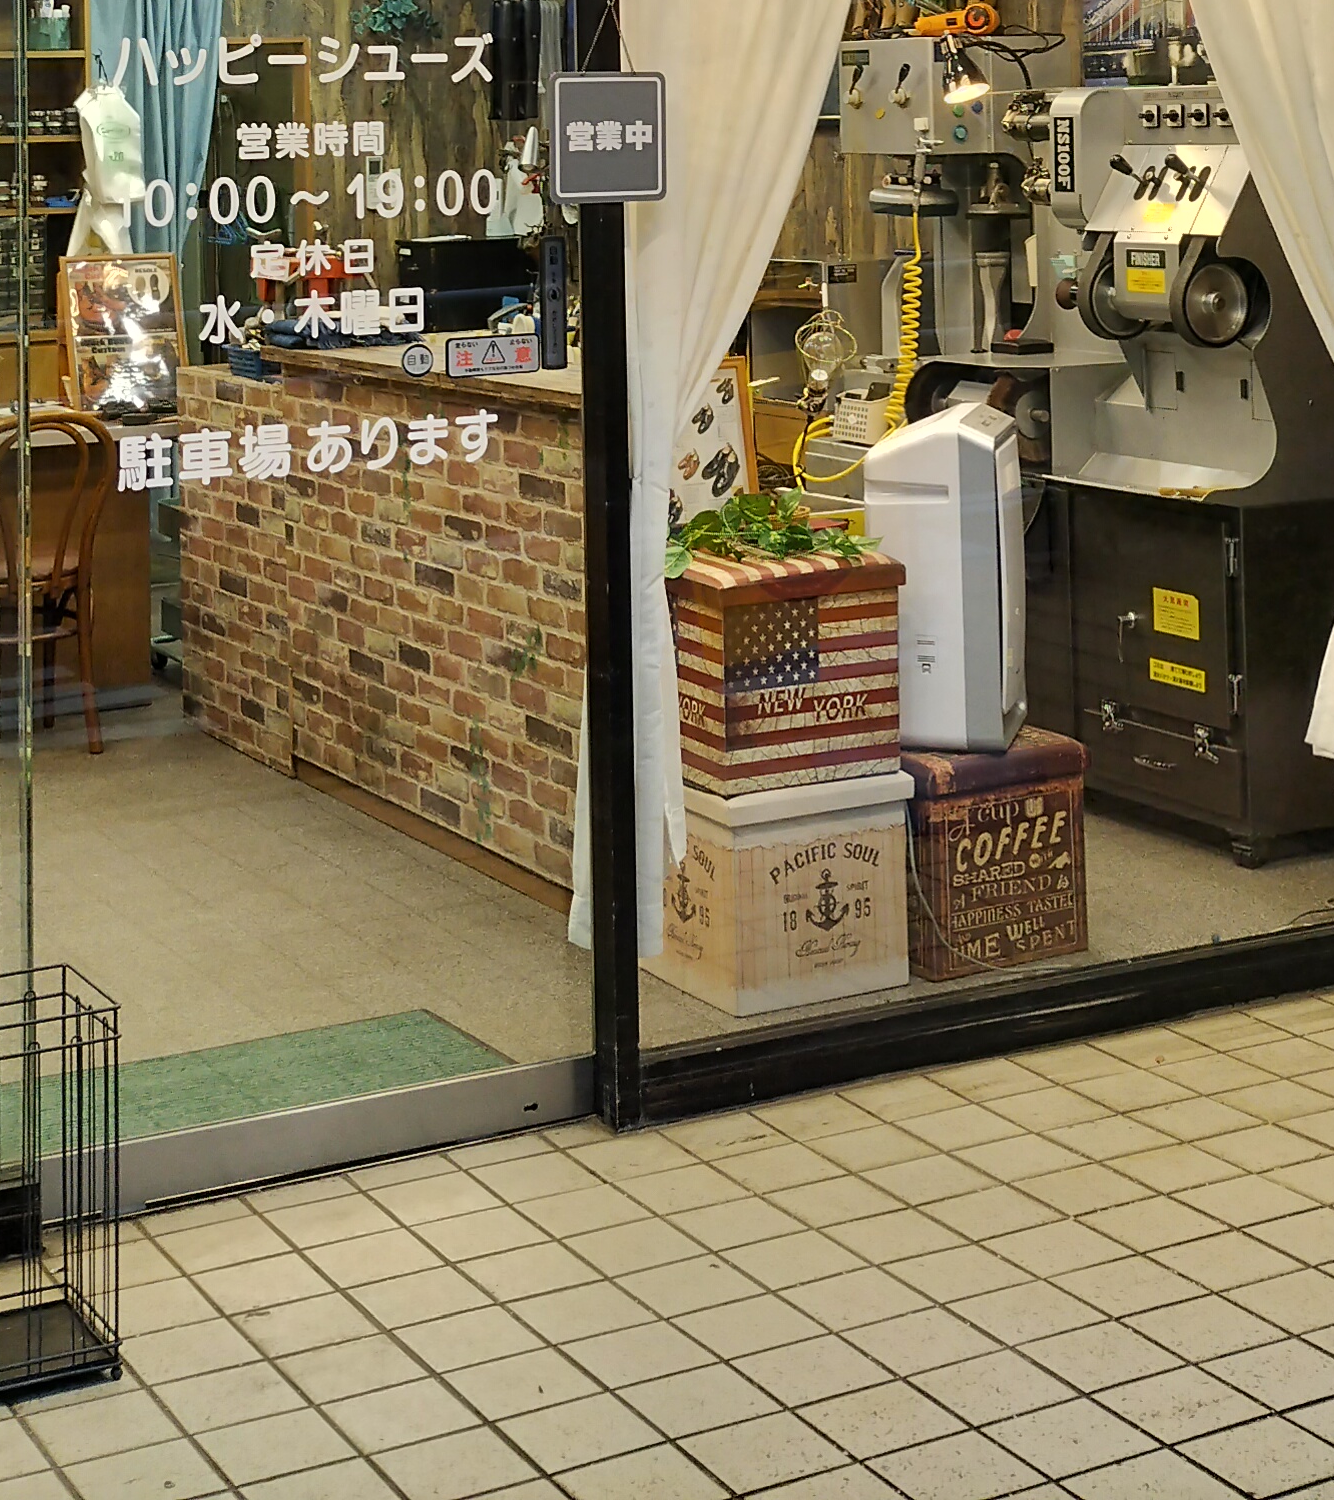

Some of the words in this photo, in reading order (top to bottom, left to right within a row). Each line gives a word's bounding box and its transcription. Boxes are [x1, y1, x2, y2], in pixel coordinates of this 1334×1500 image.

[114, 33, 494, 87] ハッピーシューズ
[235, 120, 386, 160] 営業時間
[567, 120, 654, 153] 営業中
[1056, 119, 1071, 190] NS100F
[251, 239, 375, 279] 定休日
[199, 287, 425, 345] 水・木曜日
[407, 354, 429, 365] 自動
[757, 687, 807, 715] NEW
[812, 693, 868, 722] YORK
[978, 800, 1019, 825] cup
[956, 810, 1067, 872] COFFEE
[692, 844, 716, 882] SOUL
[769, 842, 836, 885] PACIFIC
[843, 842, 880, 867] SOUL
[953, 861, 1026, 887] SHARED
[971, 874, 1052, 902] FRIEND
[783, 910, 798, 932] 18
[855, 897, 871, 919] 95
[1006, 916, 1045, 941] WELL
[1015, 919, 1075, 951] SPENT
